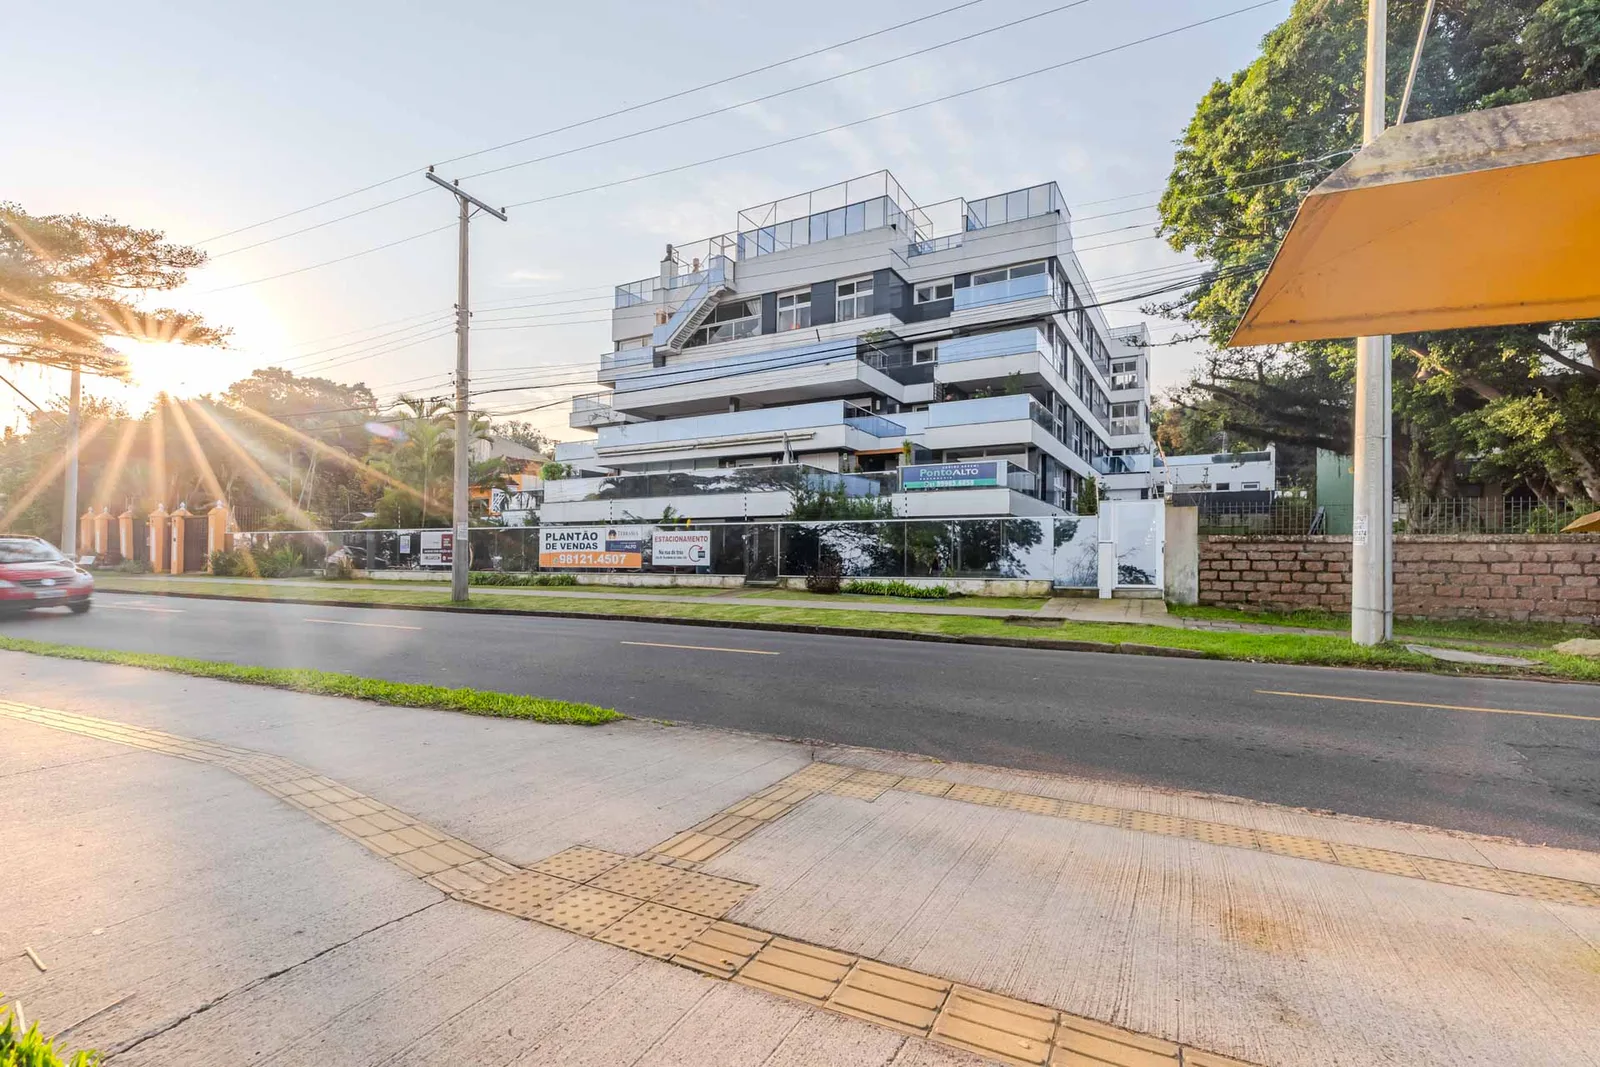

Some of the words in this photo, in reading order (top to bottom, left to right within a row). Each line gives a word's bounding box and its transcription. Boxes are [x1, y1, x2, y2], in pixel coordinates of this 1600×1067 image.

[920, 468, 979, 477] PontoALTO
[545, 530, 598, 541] PLANTÃO
[560, 542, 598, 550] VENDAS
[559, 554, 626, 564] 98121.4507
